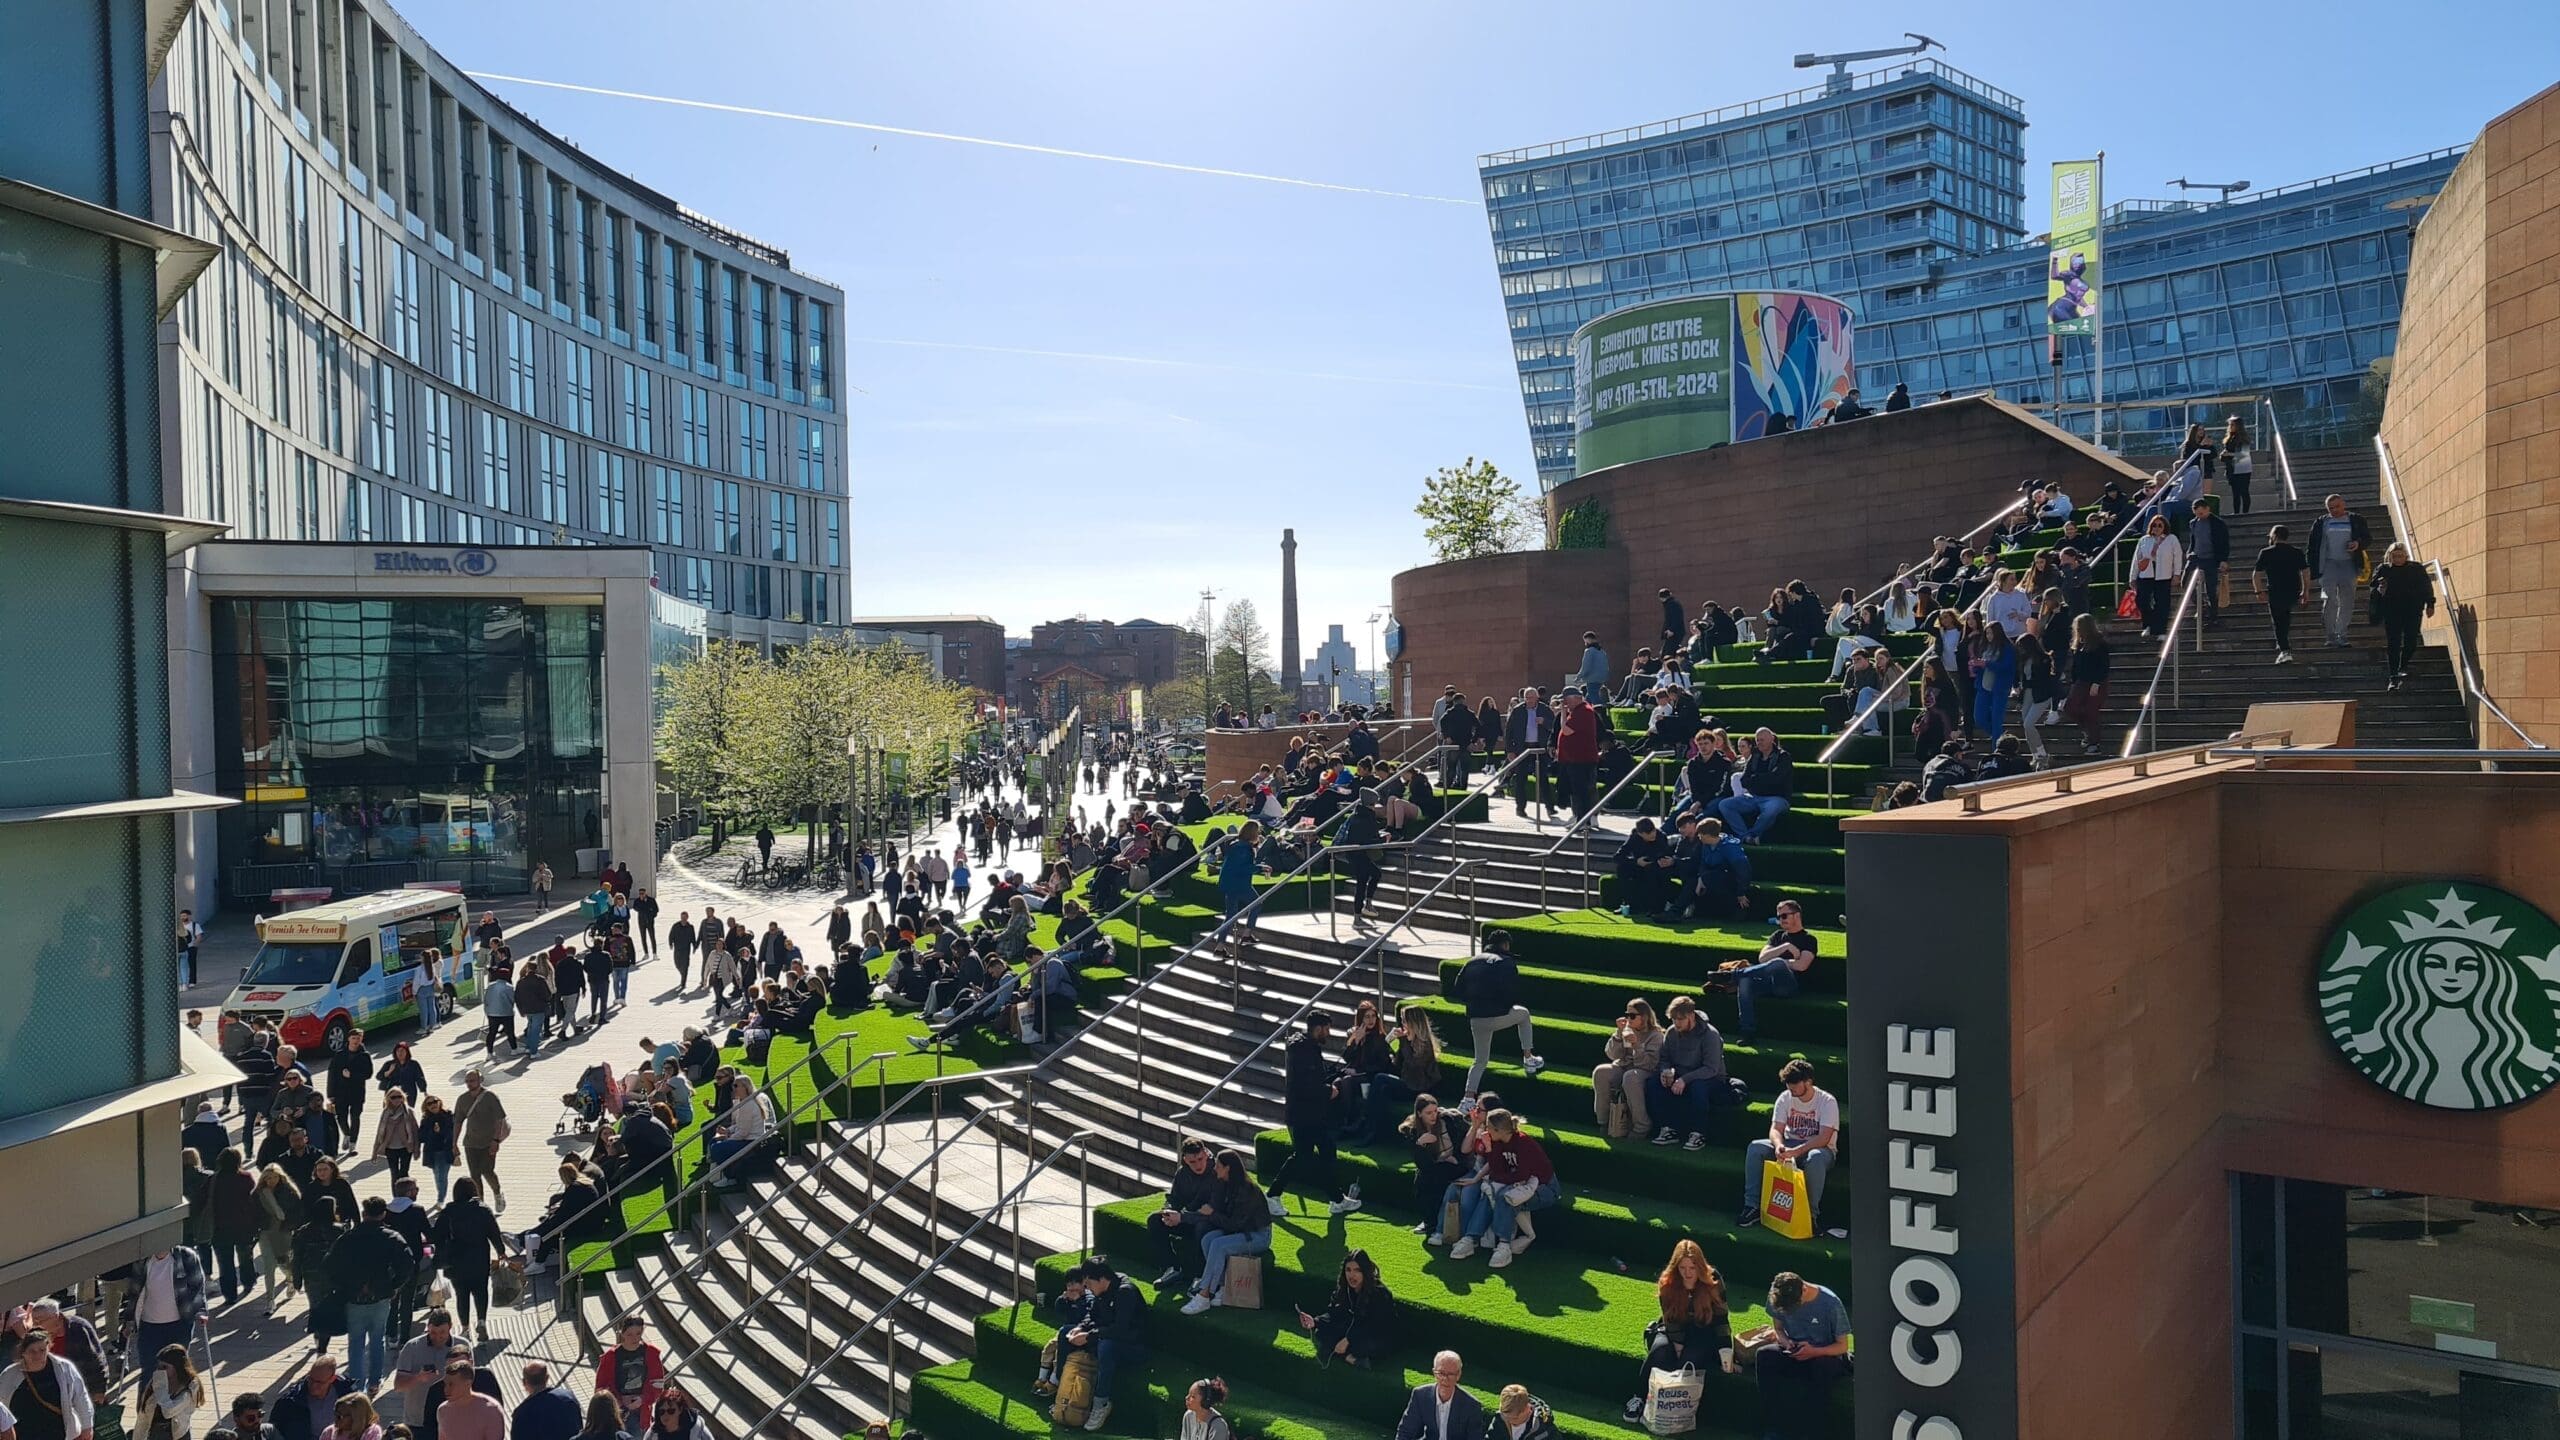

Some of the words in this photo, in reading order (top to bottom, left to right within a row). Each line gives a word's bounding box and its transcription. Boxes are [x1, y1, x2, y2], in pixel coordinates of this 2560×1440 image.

[1600, 325, 1648, 356] EXHIBITION
[1651, 317, 1702, 342] CENTRE
[1595, 350, 1639, 379] LIVERPOOL,
[1642, 342, 1678, 366] KINGS
[1681, 338, 1720, 361] DOCK
[1615, 376, 1672, 407] 4TH-5TH,
[1676, 371, 1719, 397] 2024
[374, 551, 449, 571] Hilton
[268, 924, 295, 934] Cornish
[298, 924, 309, 934] Ice
[311, 924, 337, 934] Cream
[1772, 1190, 1794, 1209] LEGO
[1887, 1023, 1963, 1387] COFFEE
